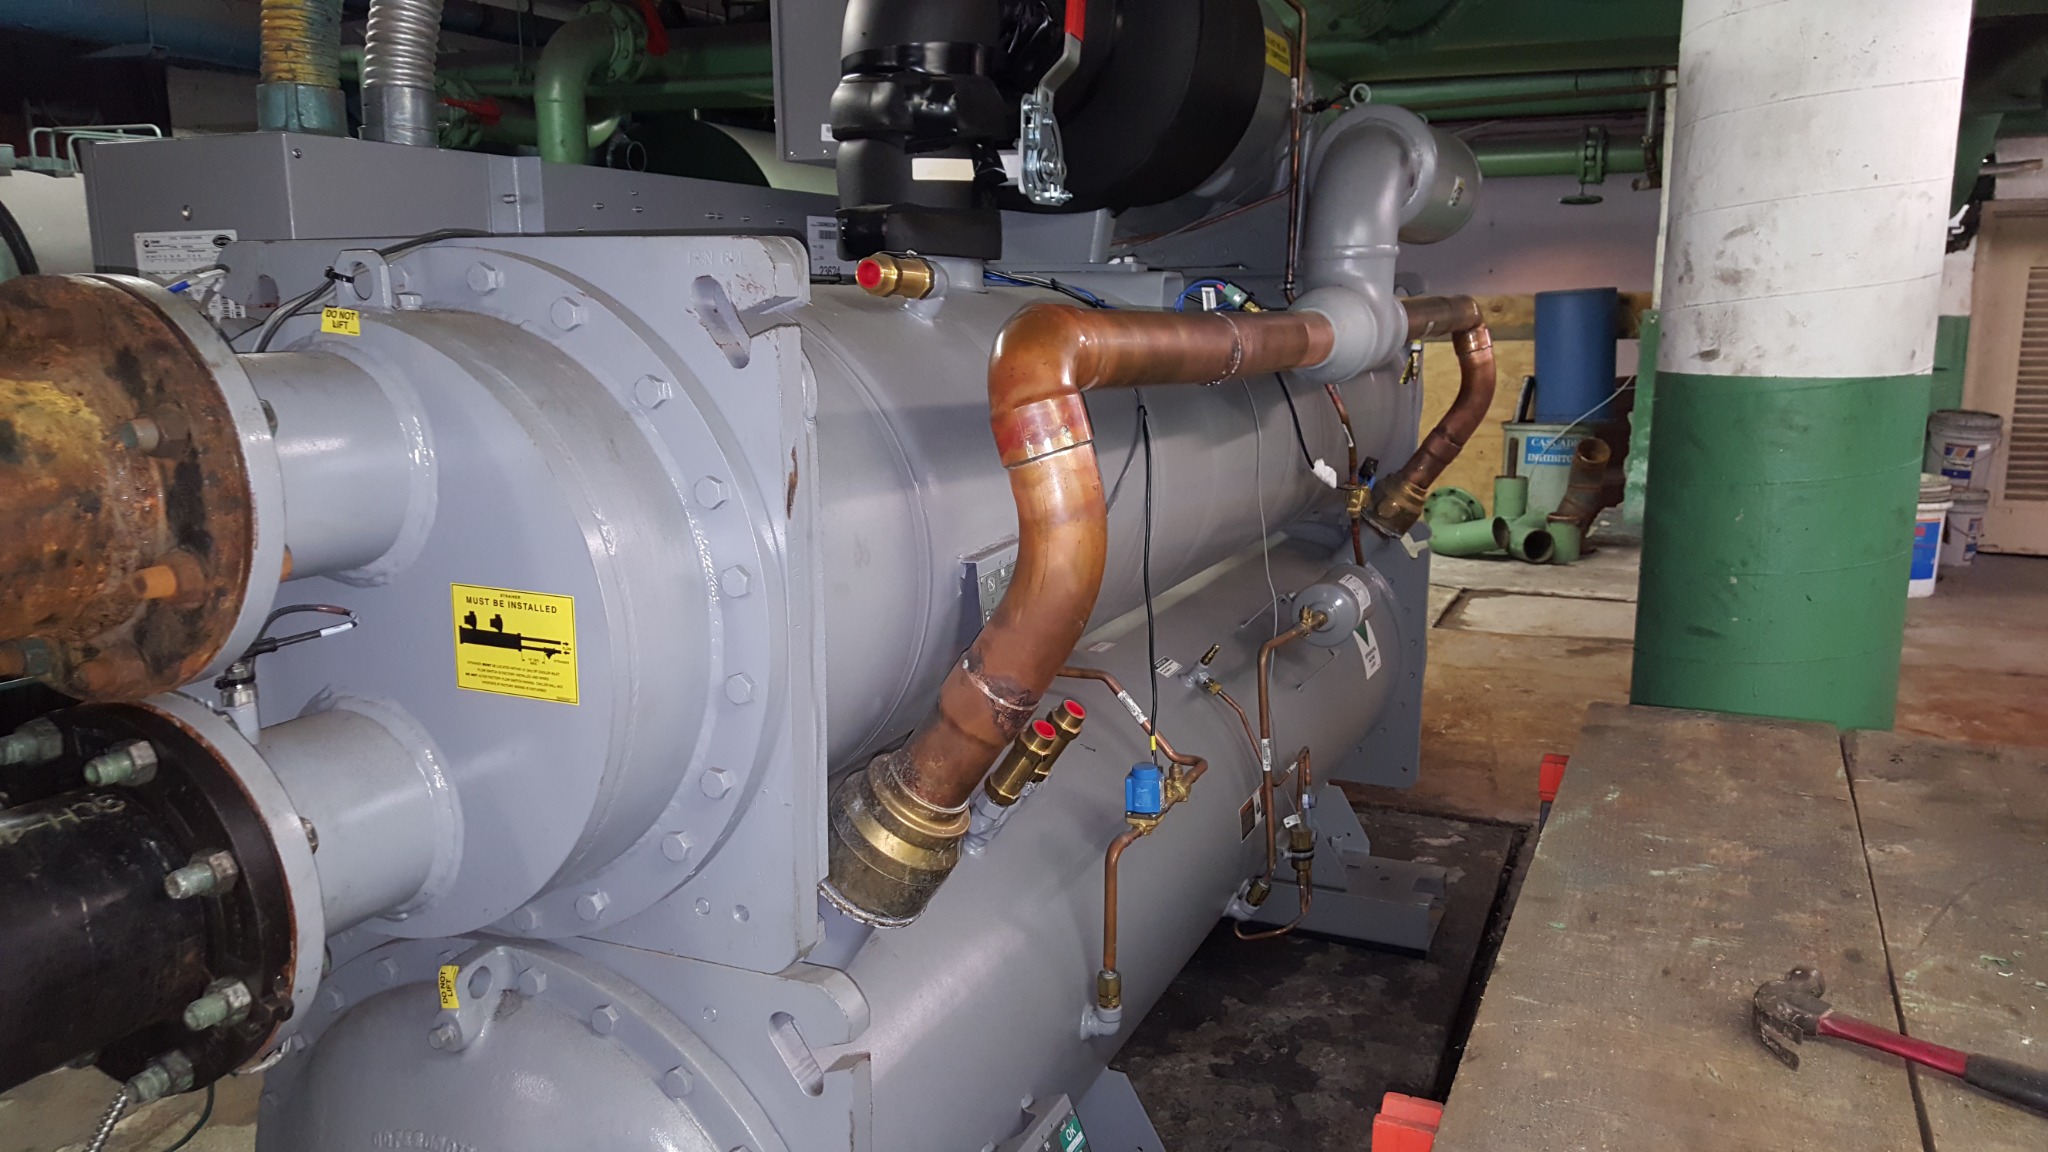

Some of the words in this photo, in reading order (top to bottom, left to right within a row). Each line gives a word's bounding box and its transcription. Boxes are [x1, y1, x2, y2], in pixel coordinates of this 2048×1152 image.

[326, 310, 338, 319] DO
[339, 311, 356, 320] NOT
[332, 319, 349, 330] LIFT
[466, 596, 490, 606] MUST
[493, 599, 505, 608] BE
[508, 602, 558, 614] INSTALLED
[446, 978, 454, 997] LIFT
[442, 992, 448, 1003] DO
[1066, 1123, 1077, 1141] OK
